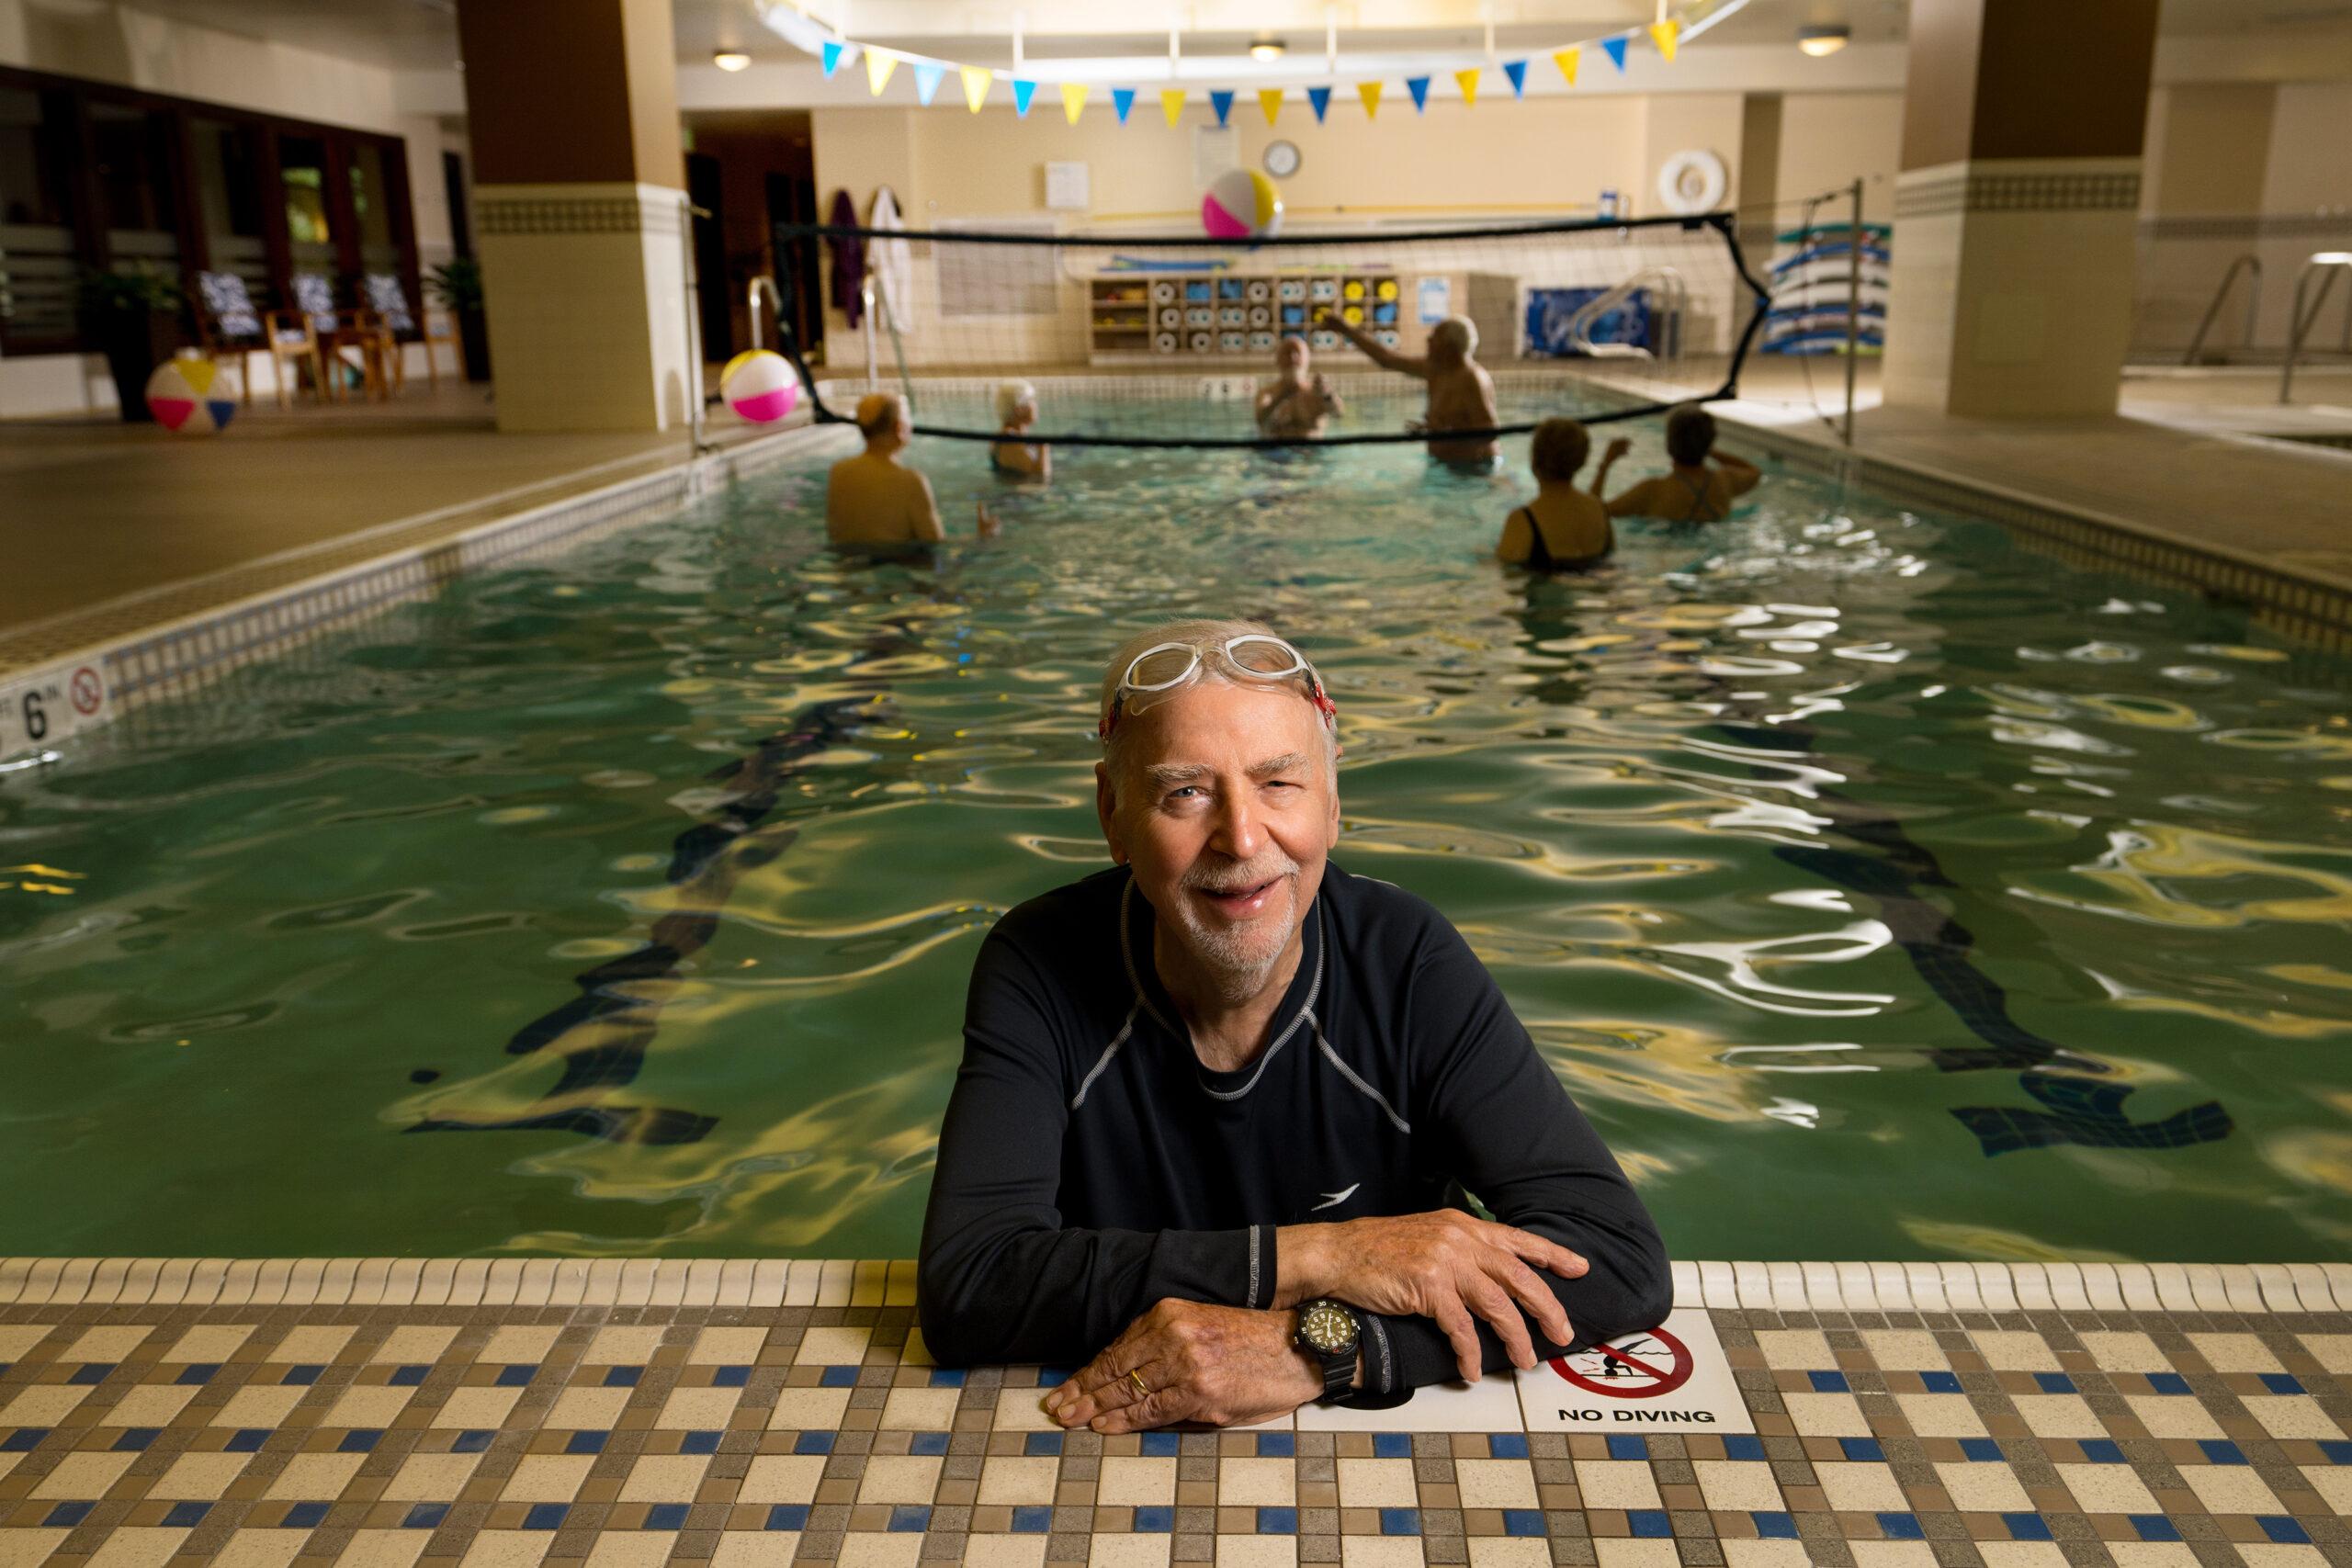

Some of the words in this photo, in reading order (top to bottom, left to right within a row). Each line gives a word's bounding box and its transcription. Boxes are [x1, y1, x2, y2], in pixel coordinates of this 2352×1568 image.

[24, 691, 47, 740] 6
[1557, 1409, 1603, 1422] NO
[1612, 1410, 1716, 1423] DIVING
